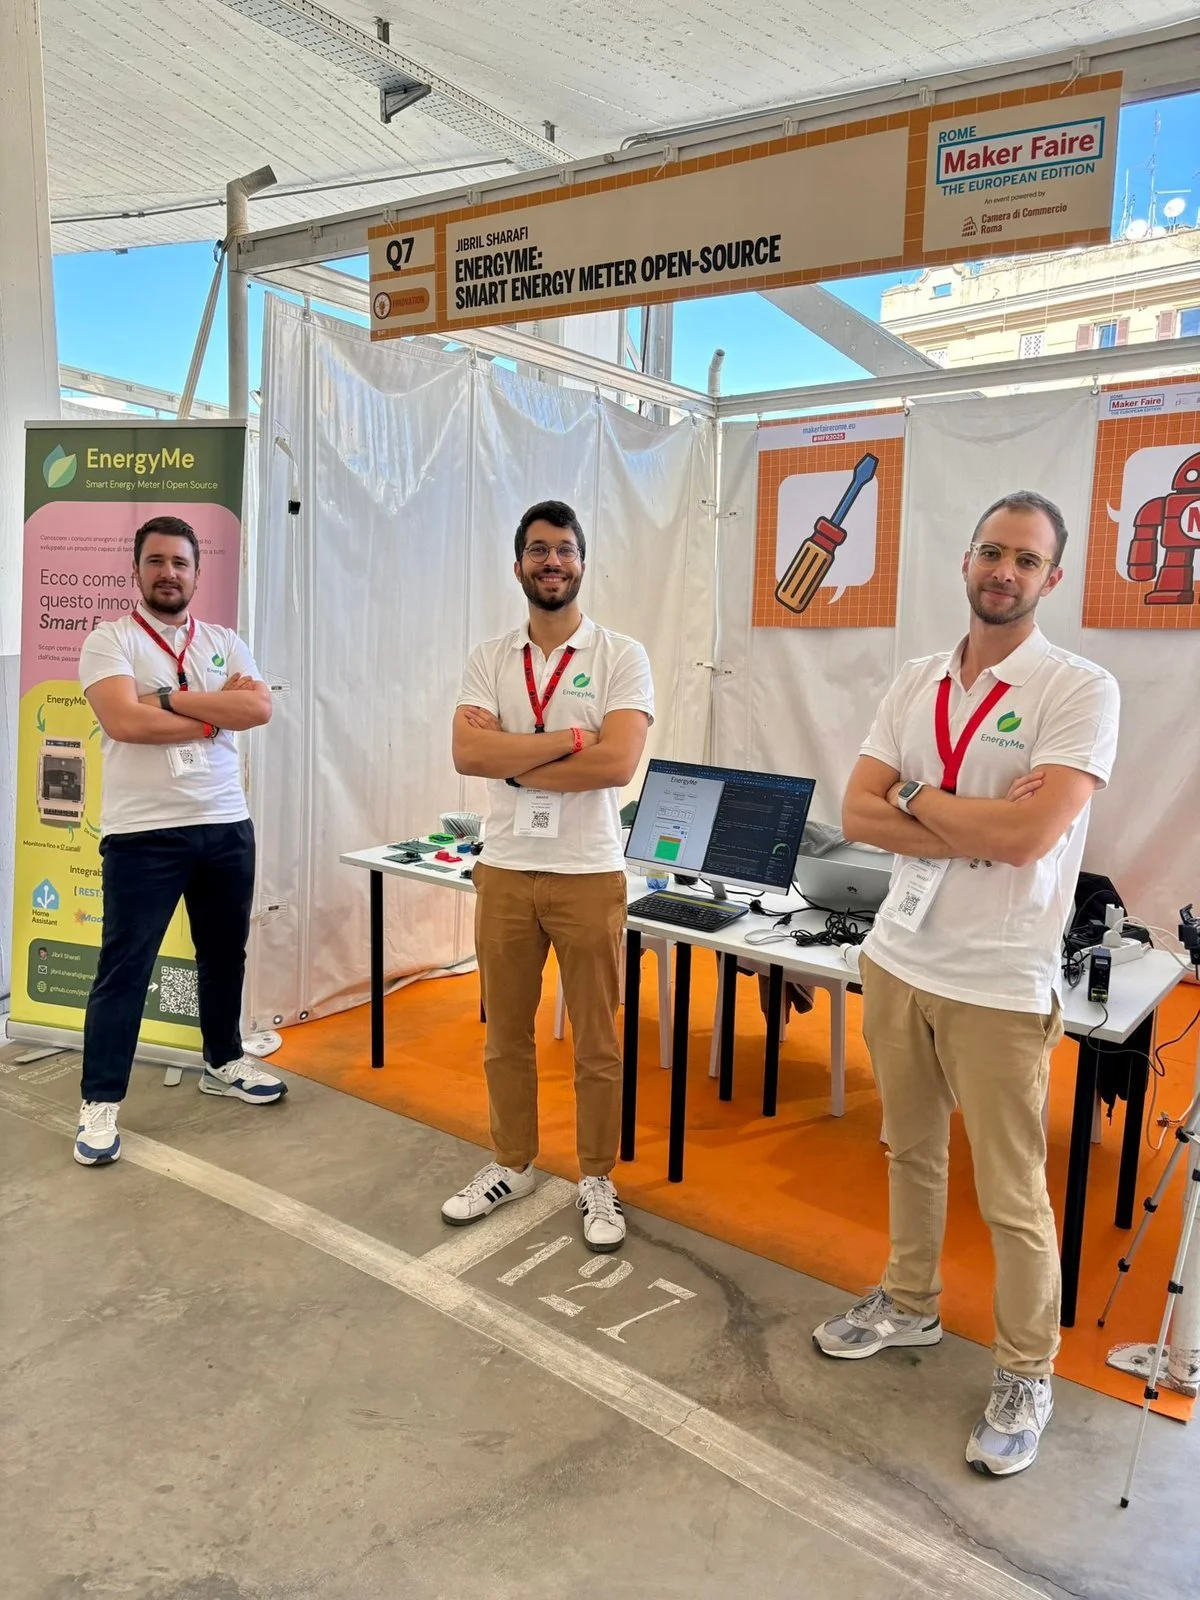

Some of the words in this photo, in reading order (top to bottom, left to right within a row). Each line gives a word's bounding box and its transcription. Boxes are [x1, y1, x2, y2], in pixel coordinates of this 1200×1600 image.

[939, 125, 977, 143] ROME
[944, 144, 1023, 174] Maker
[1031, 132, 1095, 160] Faire
[942, 184, 965, 196] THE
[969, 171, 1037, 192] EUROPEAN
[1041, 162, 1096, 181] EDITION
[1011, 191, 1037, 202] powered
[1038, 190, 1046, 198] by
[981, 211, 1011, 224] Camera
[1012, 208, 1021, 220] di
[1022, 202, 1068, 218] Commercio
[981, 224, 1002, 234] Roma
[456, 239, 485, 253] JIBRIL
[486, 226, 529, 247] SHARAFI
[386, 237, 415, 271] Q7
[455, 246, 543, 283] ENERGYME:
[455, 280, 508, 310] SMART
[511, 268, 575, 301] ENERGY
[579, 259, 637, 292] METER
[641, 234, 782, 282] OPEN-SOURCE
[1112, 400, 1139, 409] Maker
[1140, 398, 1162, 406] Faire
[802, 422, 856, 435] makerfairerome.eu
[813, 434, 845, 442] #MFR2025
[87, 447, 195, 474] EnergyMe
[86, 479, 109, 489] Smart
[109, 480, 136, 491] Energy
[137, 480, 161, 489] Meter
[166, 481, 189, 491] Open
[190, 481, 218, 490] Source
[40, 568, 78, 586] Ecco
[82, 574, 126, 588] come
[39, 594, 93, 611] questo
[97, 593, 142, 611] innov
[39, 613, 88, 631] Smart
[92, 616, 102, 631] E
[47, 694, 87, 707] EnergyMe
[562, 688, 596, 700] EnergyMe
[980, 733, 1025, 751] EnergyMe
[670, 776, 698, 786] EnergyMe
[23, 840, 46, 848] Monitora
[70, 865, 103, 878] Integrab
[79, 887, 103, 898] REST:
[32, 909, 50, 917] Home
[32, 917, 58, 926] Assistant
[496, 1235, 698, 1344] 197
